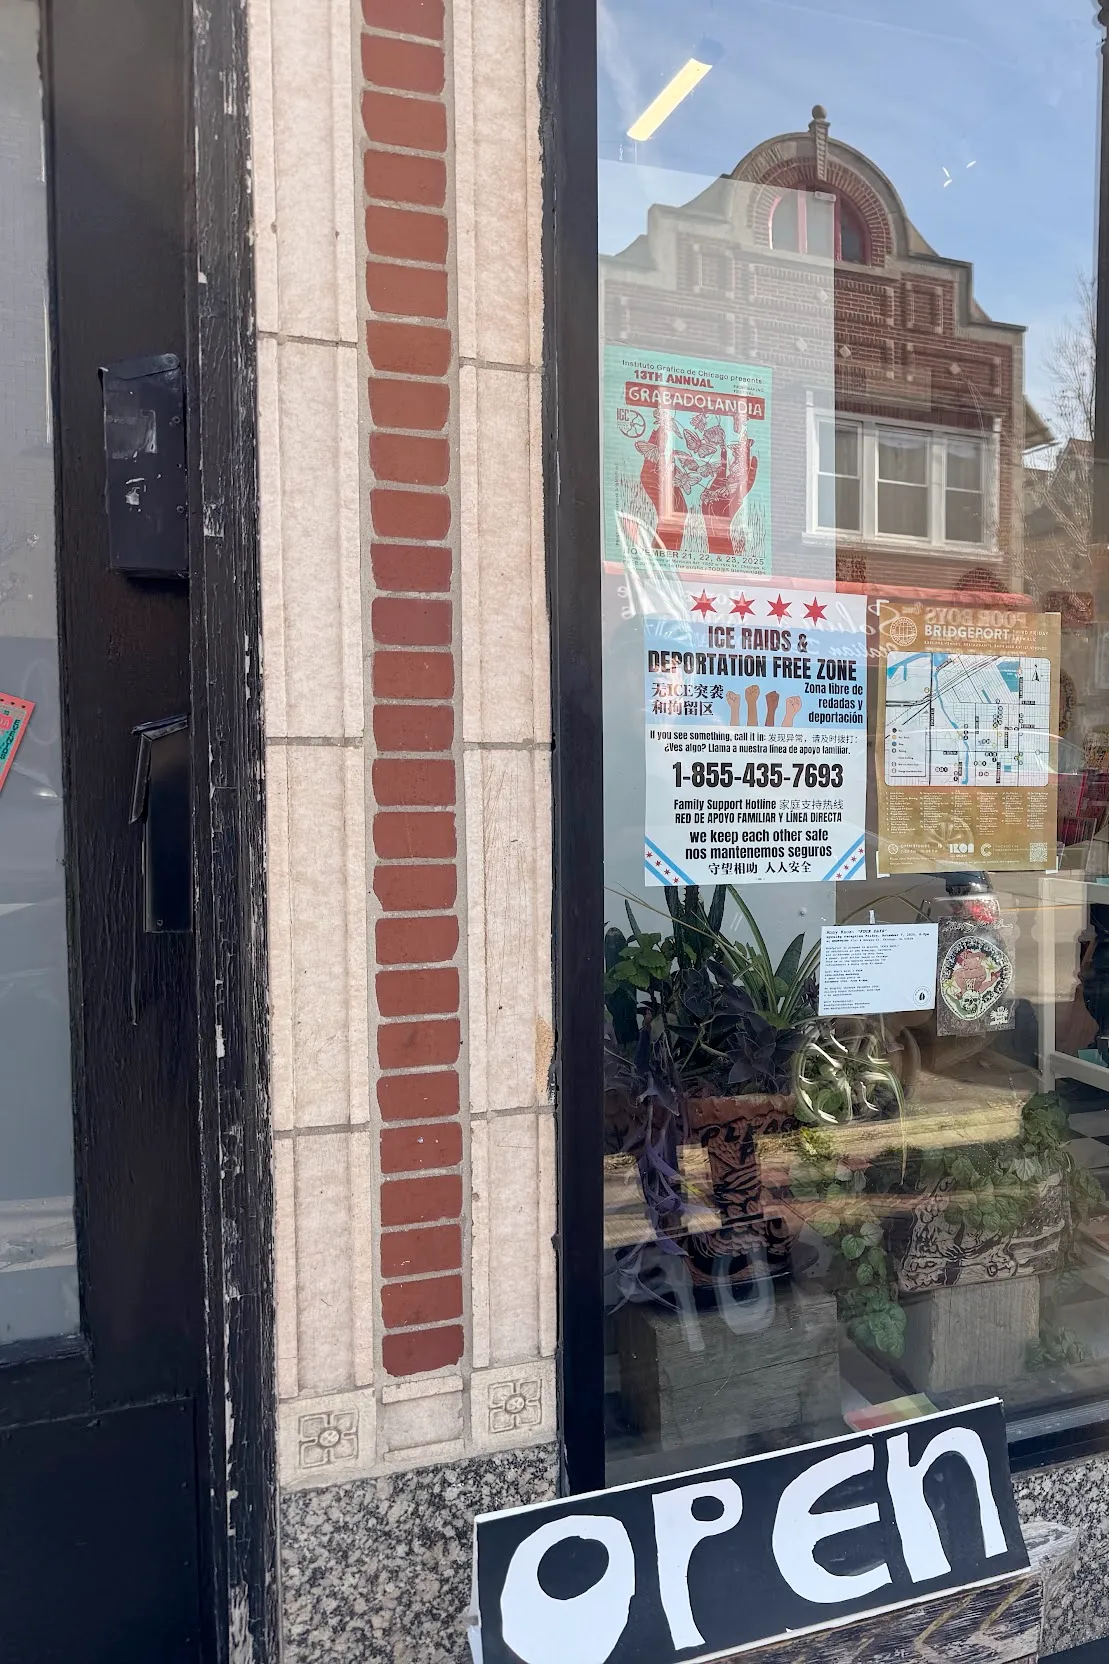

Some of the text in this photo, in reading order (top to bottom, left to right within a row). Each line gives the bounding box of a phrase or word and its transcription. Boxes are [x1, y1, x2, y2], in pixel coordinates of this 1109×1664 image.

[622, 359, 655, 371] Instituto
[656, 363, 685, 374] Gráfico
[698, 370, 729, 381] Chicago
[634, 369, 714, 389] 13TH ANNUAL
[628, 386, 763, 417] GRABADOLANDIA
[616, 407, 630, 421] IGC
[626, 547, 679, 560] OEMBER
[699, 553, 713, 563] 22,
[716, 554, 723, 562] &
[726, 555, 740, 565] 23,
[742, 557, 765, 567] 2025
[708, 626, 735, 649] ICE
[742, 628, 791, 652] RAIDS
[797, 633, 808, 653] &
[924, 624, 1010, 640] BRIDGEPORT
[648, 651, 857, 681] DEPORTATION FREE ZONE
[652, 682, 724, 700] 无ICE突袭
[804, 682, 863, 695] Zona libre de
[651, 699, 714, 717] 和拘留区
[818, 697, 863, 711] redadas y
[808, 711, 863, 725] deportación
[650, 730, 655, 740] If
[657, 732, 672, 743] you
[673, 731, 688, 740] see
[689, 731, 733, 742] something,
[734, 731, 748, 742] call
[749, 731, 755, 741] it
[757, 731, 766, 742] in:
[664, 743, 851, 756] ¿Ves algo? Llama a nuestra línea de apoyo familiar.
[672, 761, 844, 788] 1-855-435-7693
[674, 799, 844, 812] Family Support Hotline 家庭支持热线
[675, 811, 842, 824] RED DE APOYO FAMILIAR Y LÍNEA DIRECTA
[689, 828, 829, 844] we keep each other safe
[685, 844, 832, 860] nos mantenemos seguros
